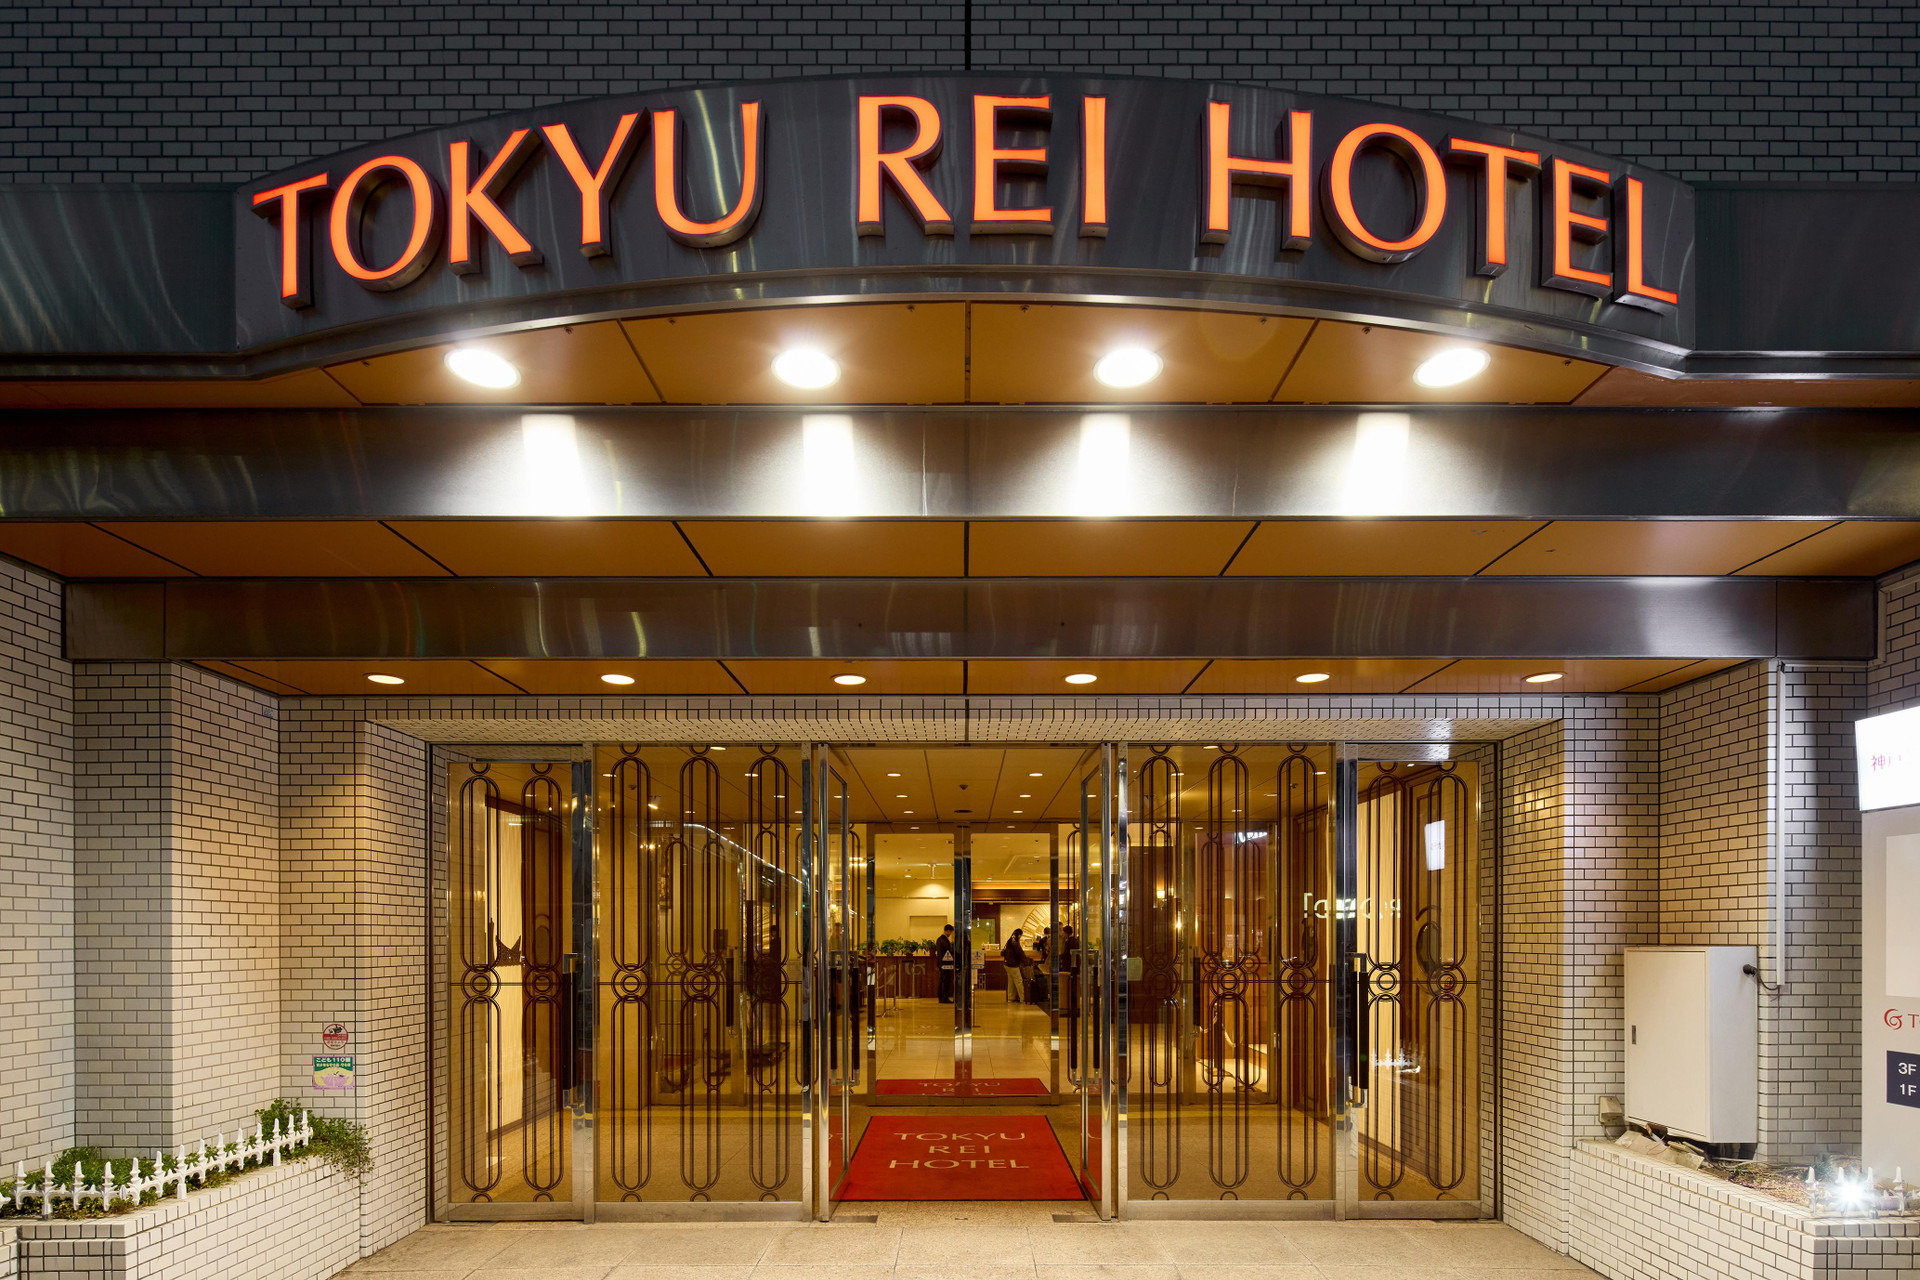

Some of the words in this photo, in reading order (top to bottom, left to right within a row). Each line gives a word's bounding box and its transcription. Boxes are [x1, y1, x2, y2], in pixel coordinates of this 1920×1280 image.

[252, 101, 764, 306] TOKYU
[857, 94, 1108, 229] REI
[1203, 100, 1679, 307] HOTEL
[1907, 1013, 1920, 1029] T
[1898, 1062, 1917, 1075] 3F
[1899, 1083, 1917, 1096] 1F
[893, 1132, 1026, 1141] TOKYU
[928, 1145, 991, 1154] REI
[888, 1159, 1030, 1169] HOTEL
